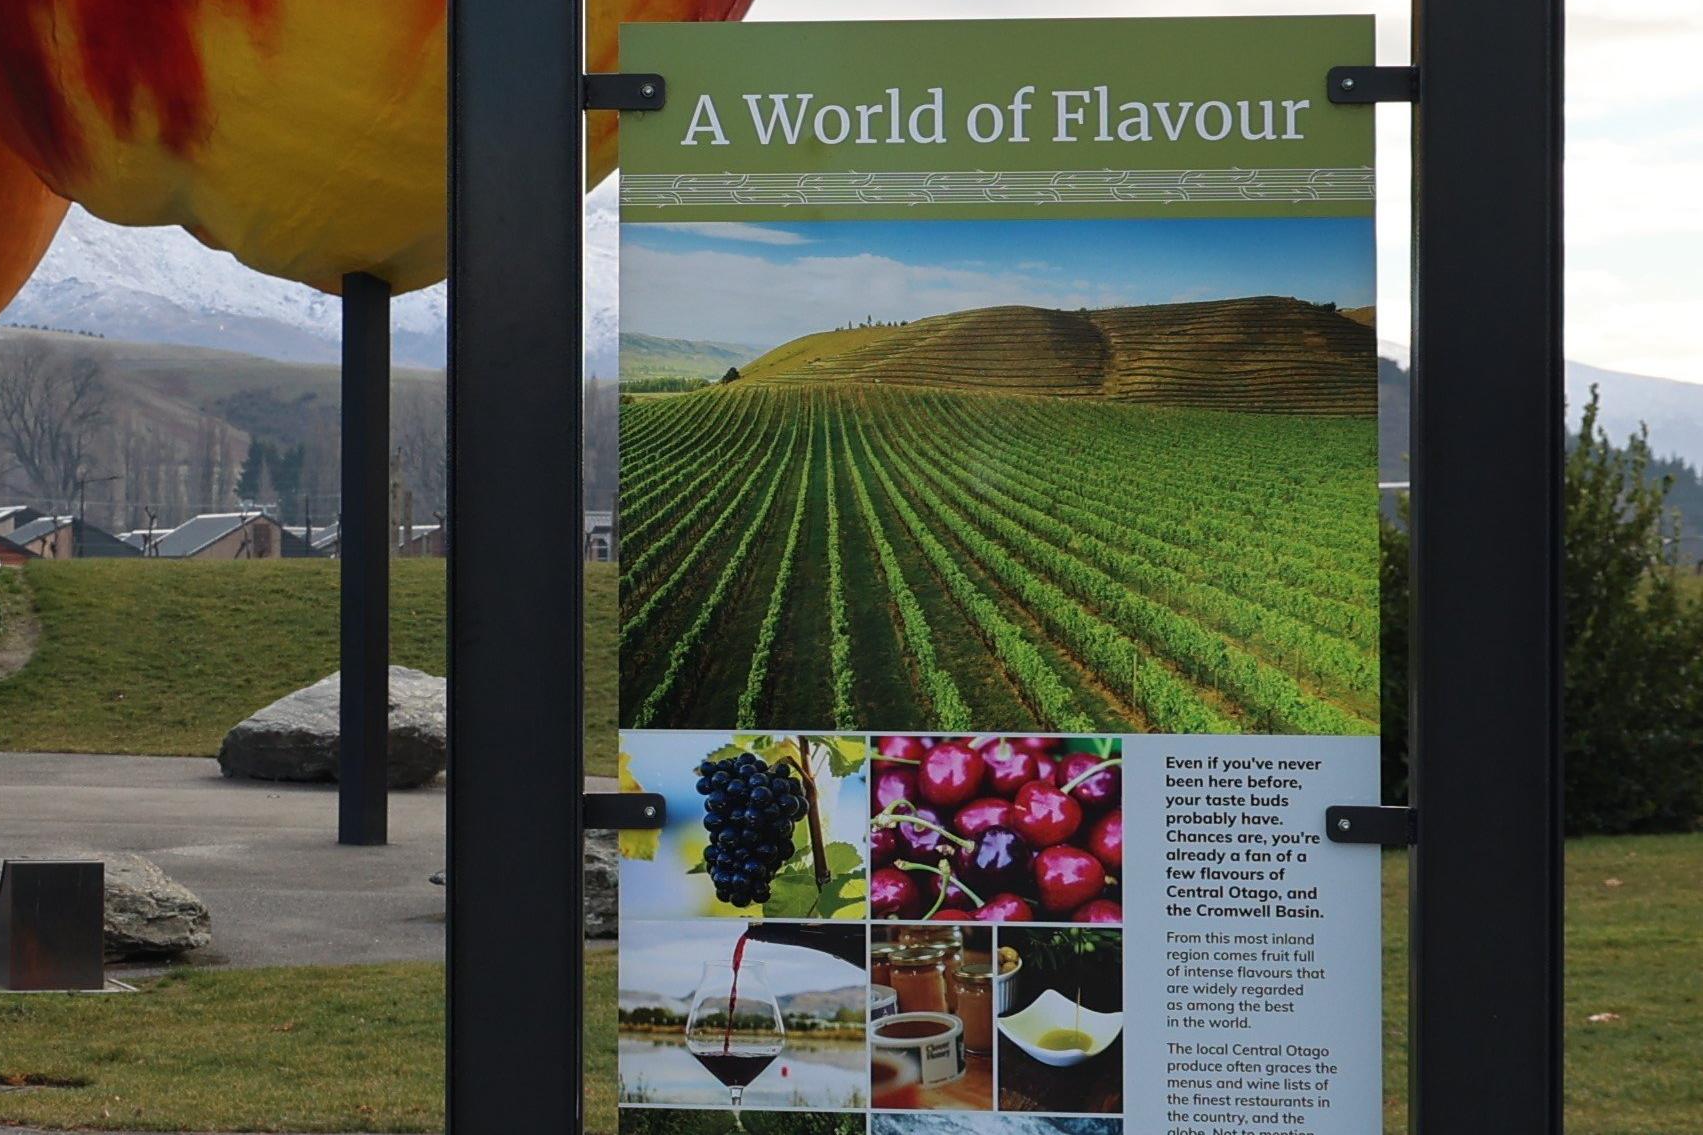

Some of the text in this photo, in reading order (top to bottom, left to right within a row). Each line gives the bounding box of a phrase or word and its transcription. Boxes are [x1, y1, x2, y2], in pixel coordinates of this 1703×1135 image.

[680, 85, 1310, 146] A World of Flavour
[1165, 755, 1323, 773] Even if you've never
[1165, 773, 1303, 791] been here before,
[1165, 793, 1290, 810] your taste buds
[1165, 811, 1284, 829] probably have.
[1165, 829, 1321, 848] Chances are, you're
[1165, 847, 1307, 865] already a fan of a
[1165, 865, 1286, 881] few flavours of
[1166, 884, 1318, 903] Central Otago, and
[1165, 902, 1324, 919] the Cromwell Basin.
[1166, 931, 1315, 946] From this most inland
[1166, 948, 1315, 964] region comes fruit full
[1166, 964, 1325, 980] of intense flavours that
[1166, 982, 1304, 999] are widely regarded
[1166, 999, 1295, 1015] as among the best
[1166, 1014, 1252, 1029] in the world.
[1167, 1042, 1330, 1061] The local Central Otago
[1166, 1059, 1338, 1077] produce often graces the
[1167, 1076, 1330, 1092] menus and wine lists of
[1166, 1092, 1331, 1109] the finest restaurants in
[1167, 1109, 1305, 1126] the country, and the
